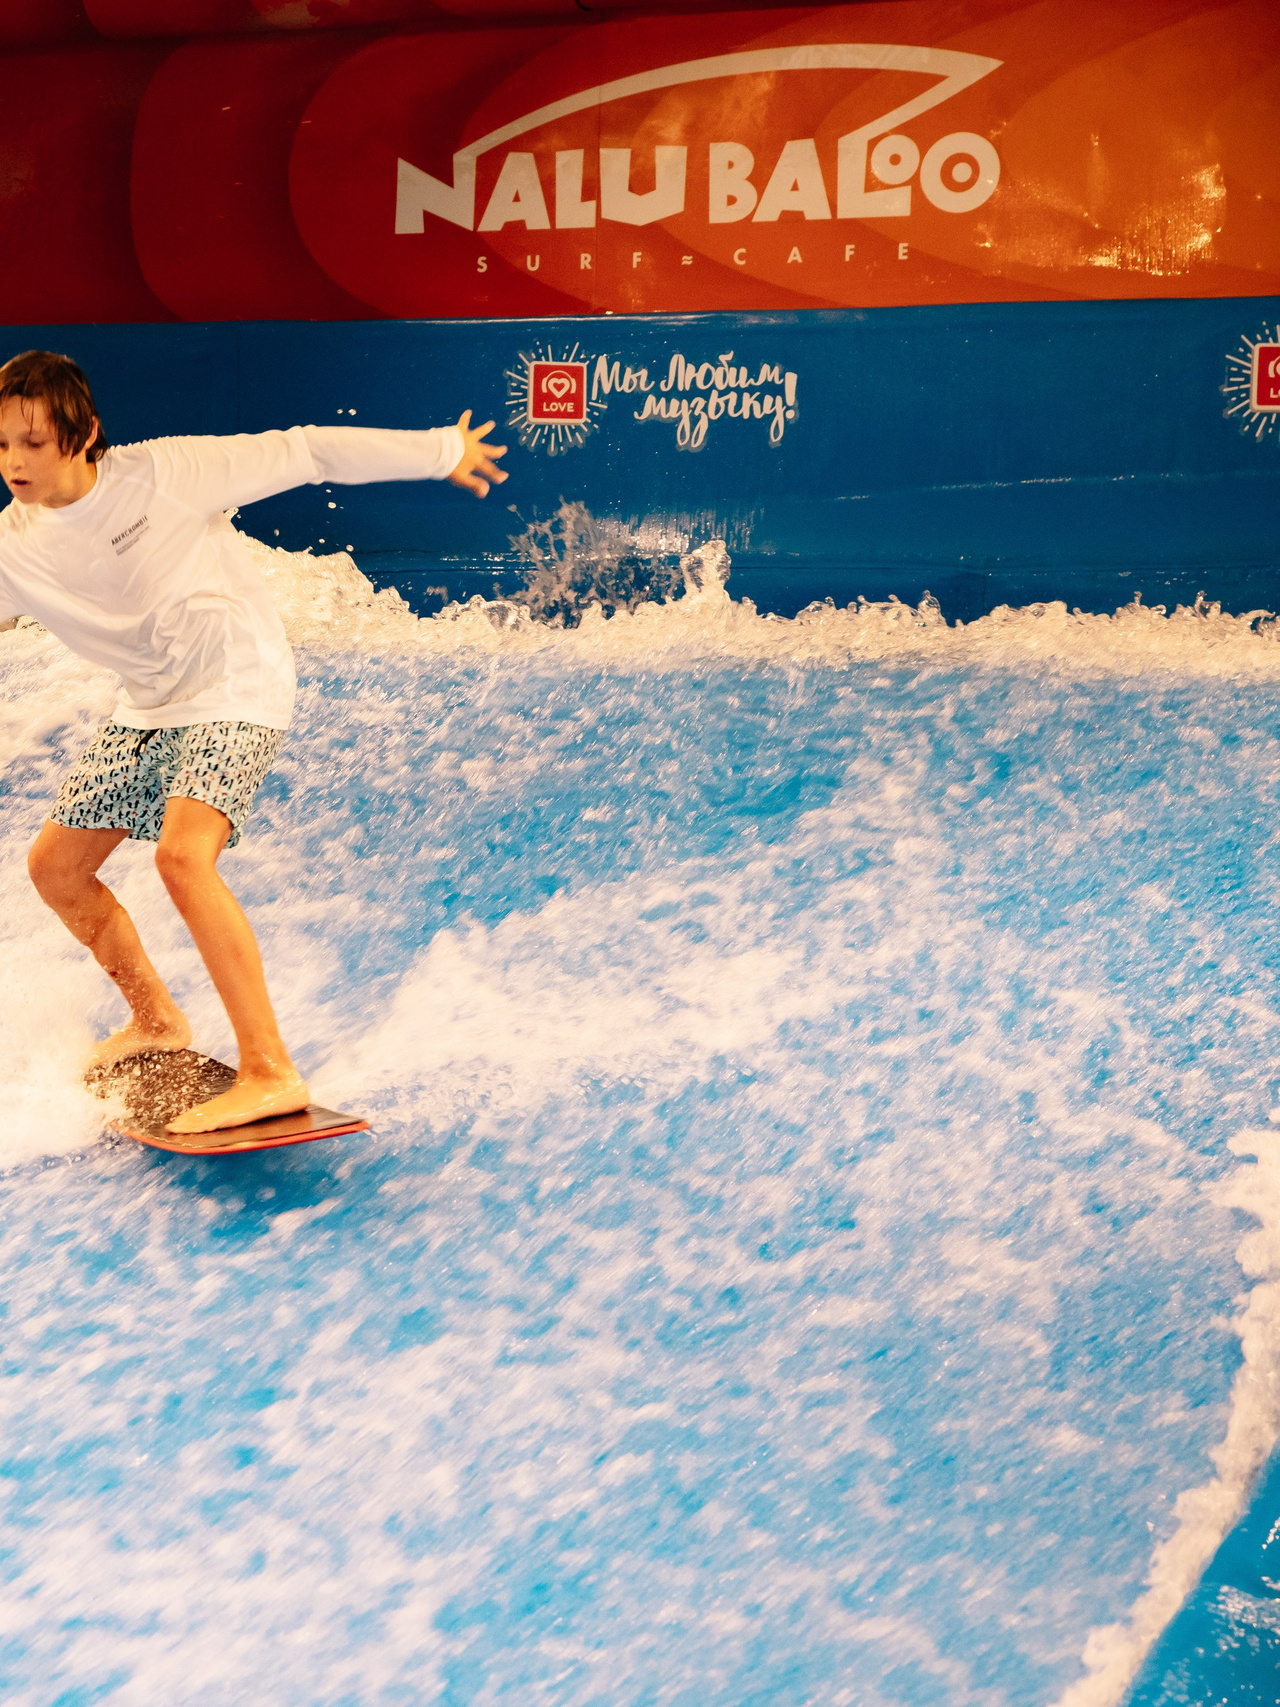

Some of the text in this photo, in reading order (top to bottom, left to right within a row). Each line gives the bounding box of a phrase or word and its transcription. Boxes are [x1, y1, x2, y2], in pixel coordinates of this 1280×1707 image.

[395, 131, 1000, 234] NALU BALOO
[477, 242, 908, 273] SURF CAFE
[591, 351, 784, 400] Мы Любим
[543, 401, 574, 413] LOVE
[634, 372, 798, 448] музыку!
